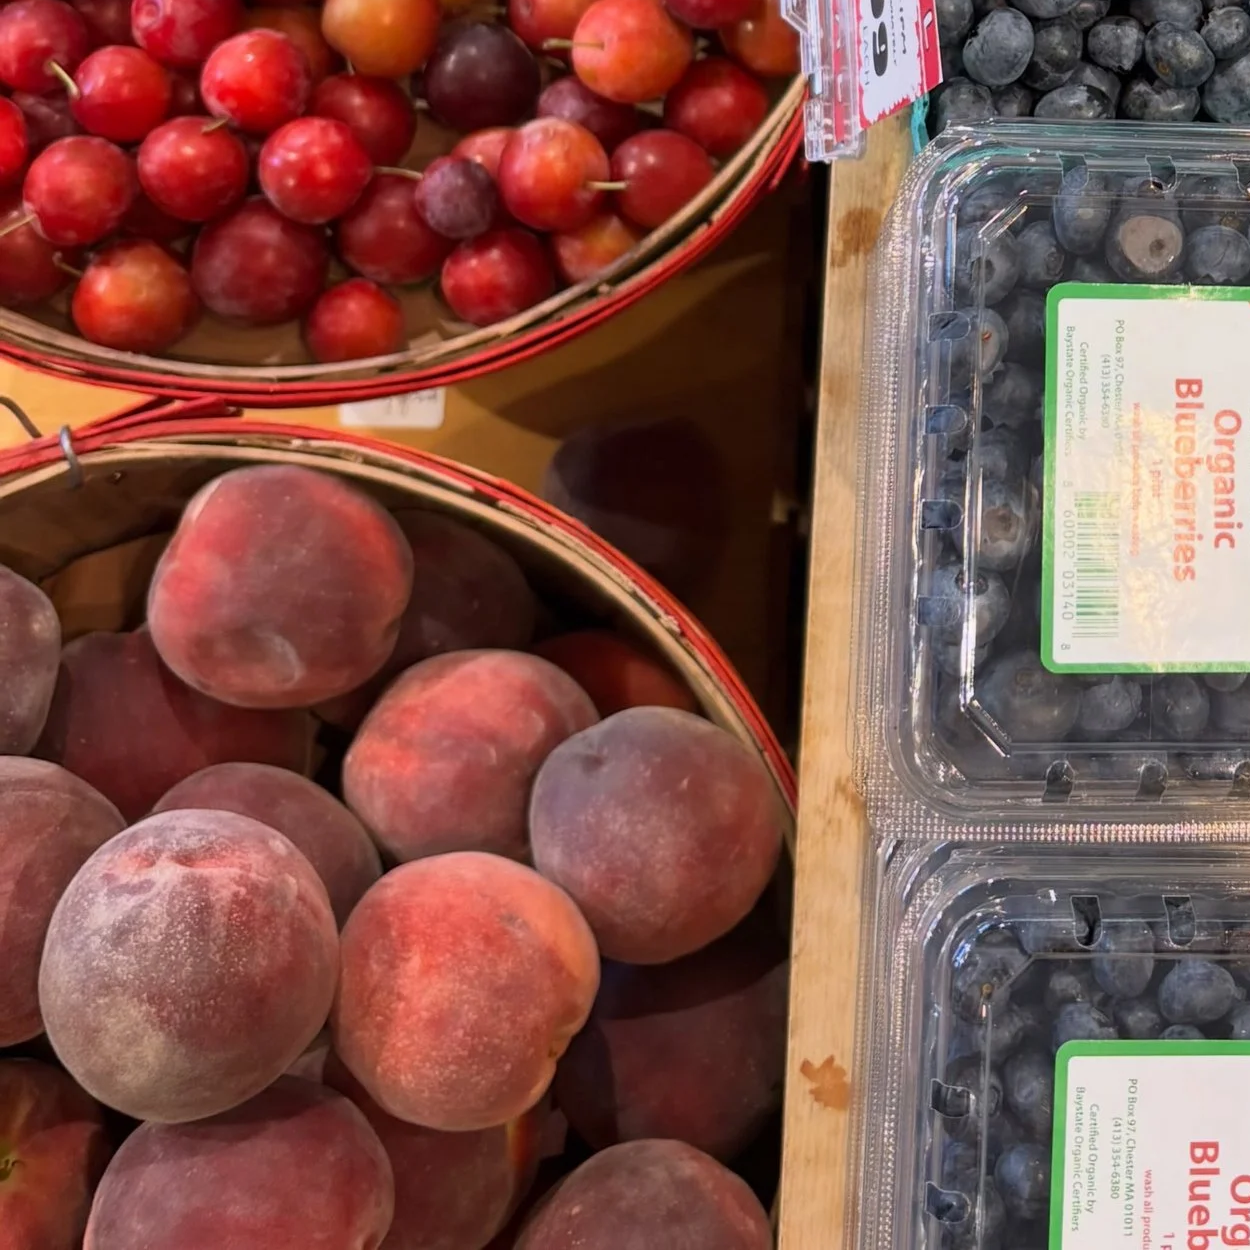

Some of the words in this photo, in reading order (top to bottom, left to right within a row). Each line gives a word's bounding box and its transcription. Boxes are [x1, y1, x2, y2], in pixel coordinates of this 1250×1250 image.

[1063, 325, 1075, 369] Baystate
[1114, 319, 1125, 335] PO
[1114, 336, 1124, 356] Box
[1077, 341, 1089, 385] Certified
[1099, 354, 1112, 380] (413)
[1111, 356, 1124, 372] 97,
[1062, 369, 1075, 410] Organic
[1075, 386, 1089, 426] Organic
[1075, 428, 1088, 442] by
[1172, 378, 1205, 582] Blueberries
[1205, 409, 1243, 549] Organic
[1060, 570, 1075, 621] 03140
[1126, 1079, 1138, 1096] PO
[1126, 1097, 1137, 1118] Box
[1072, 1086, 1086, 1134] Baystate
[1087, 1103, 1100, 1151] Certified
[1122, 1119, 1136, 1137] 97,
[1109, 1117, 1123, 1146] (413)
[1070, 1135, 1084, 1179] Organic
[1083, 1153, 1098, 1197] Organic
[1107, 1147, 1122, 1200] 354-6380
[1124, 1138, 1136, 1181] Chester
[1069, 1180, 1083, 1231] Certifiers
[1082, 1199, 1096, 1214] by
[1123, 1182, 1135, 1202] MA
[1122, 1203, 1134, 1237] 01011
